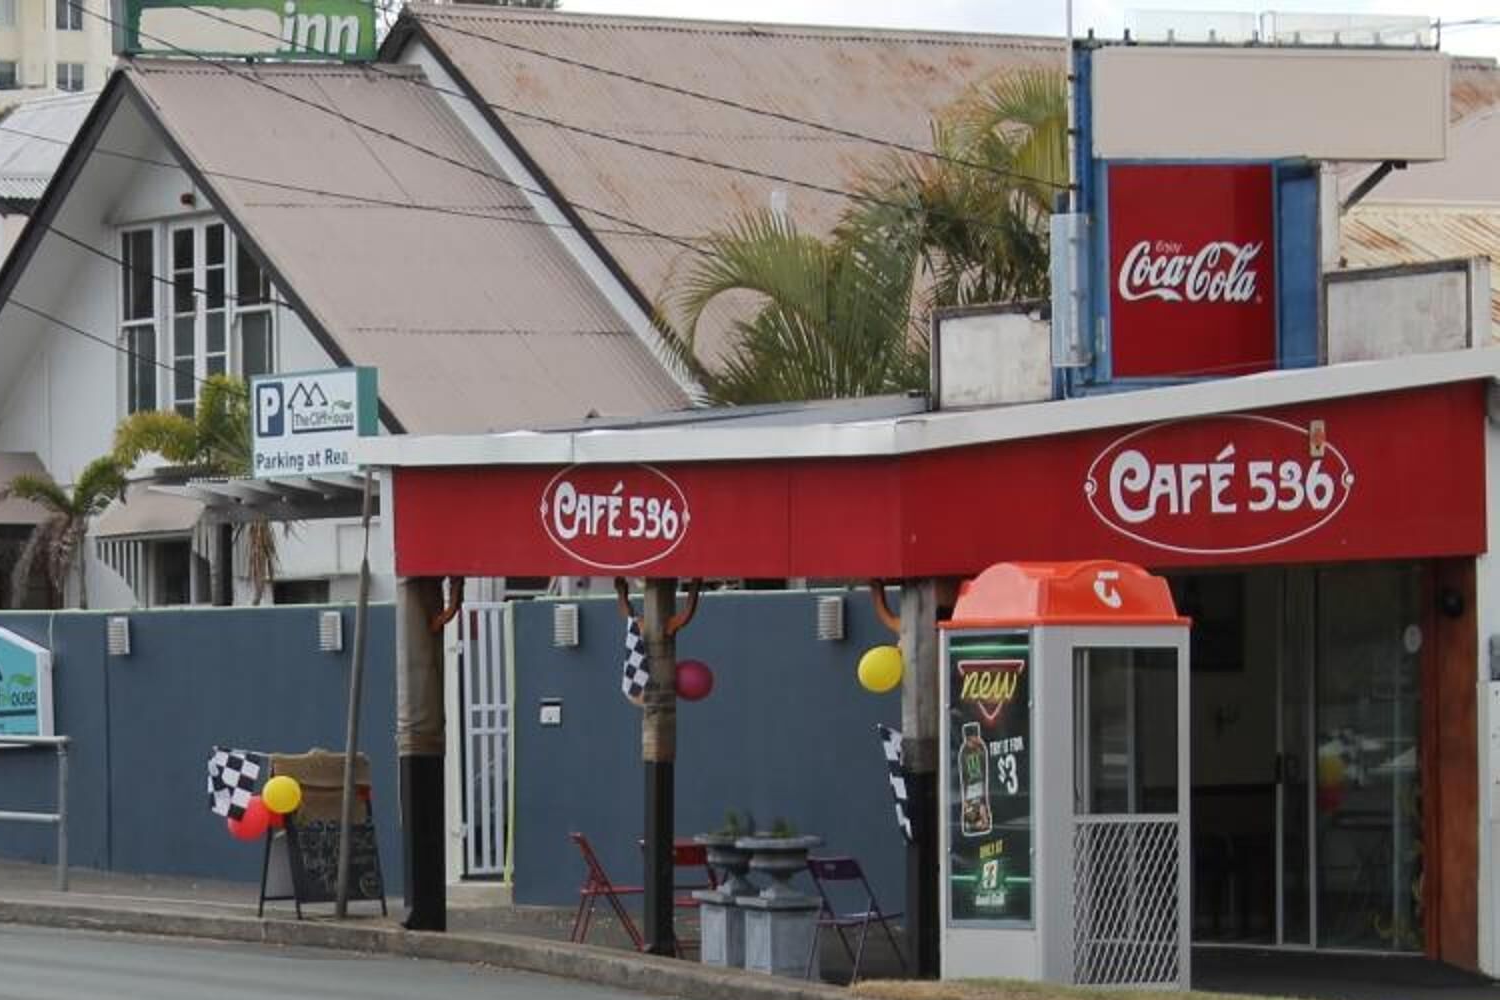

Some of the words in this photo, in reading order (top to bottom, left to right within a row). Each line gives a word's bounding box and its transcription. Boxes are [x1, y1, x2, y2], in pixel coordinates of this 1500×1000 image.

[284, 1, 360, 54] inn
[1119, 240, 1263, 302] Coca-Cola
[259, 387, 280, 433] P
[256, 451, 304, 472] Parking
[308, 452, 321, 467] at
[1248, 459, 1335, 511] 536
[629, 497, 678, 540] 536
[961, 671, 1017, 700] new
[998, 754, 1018, 794] $3
